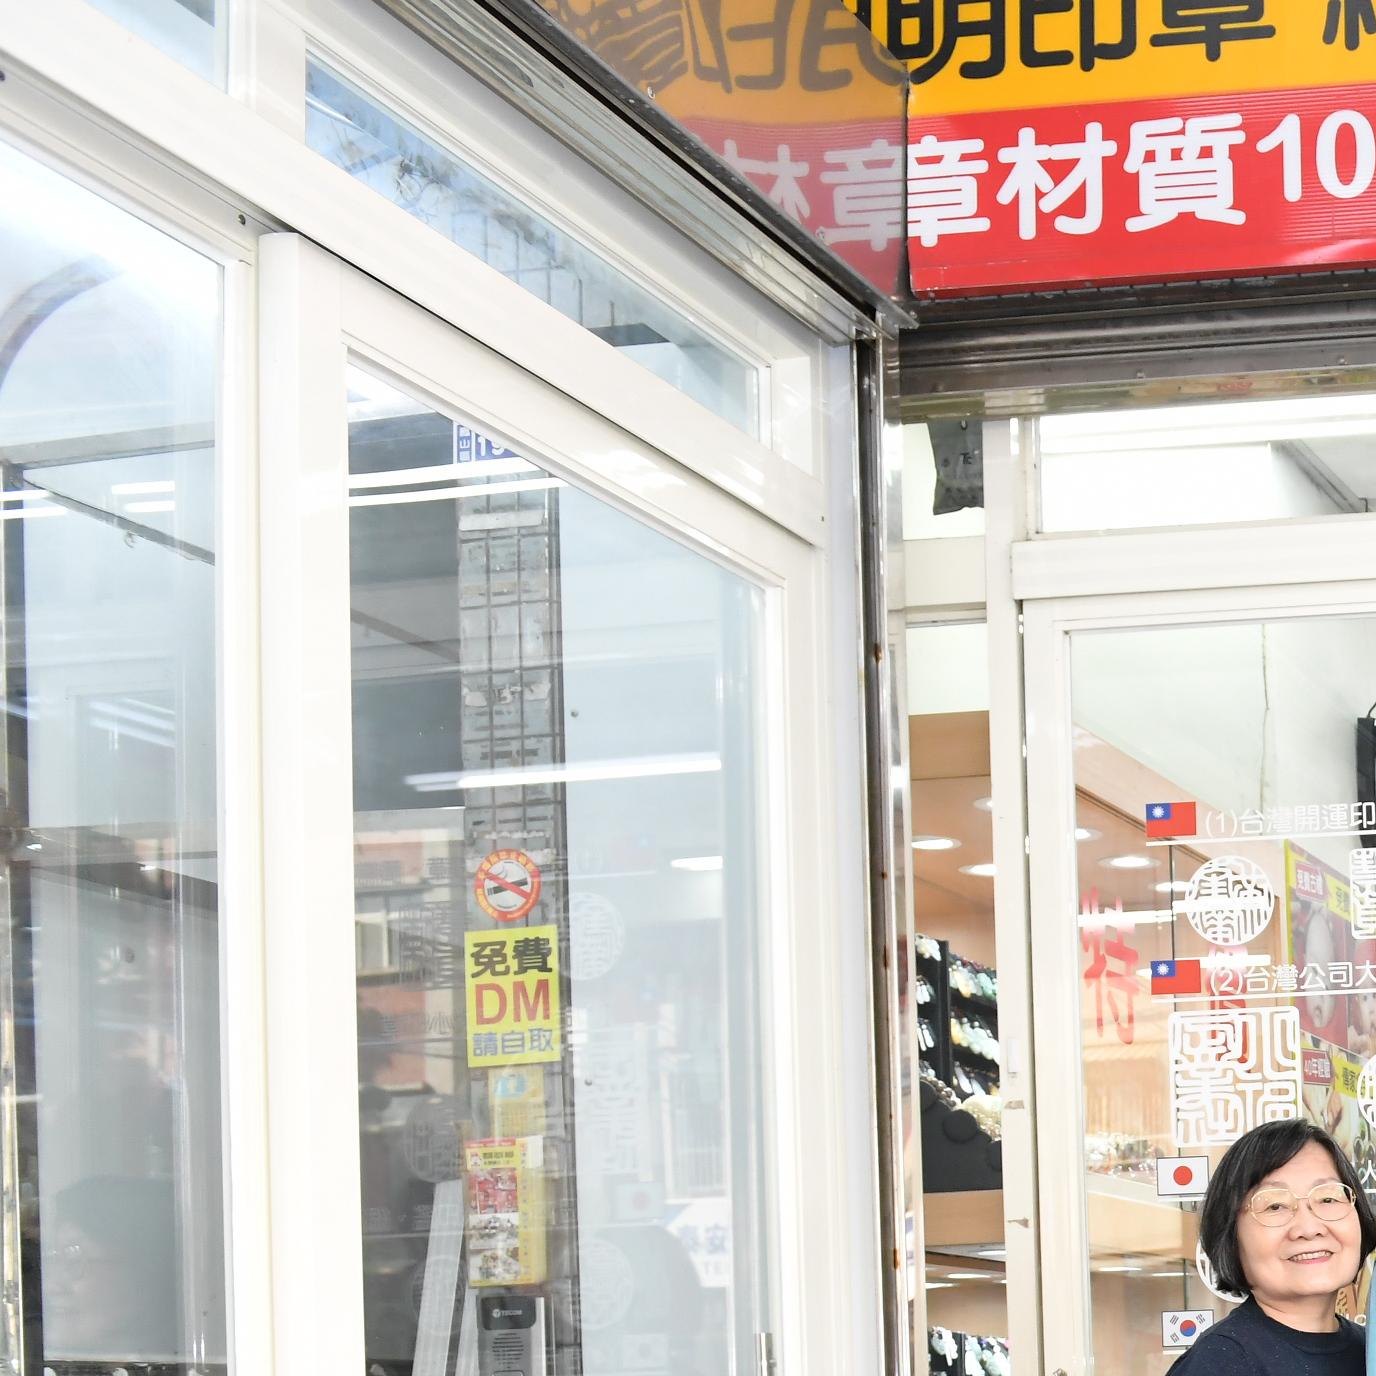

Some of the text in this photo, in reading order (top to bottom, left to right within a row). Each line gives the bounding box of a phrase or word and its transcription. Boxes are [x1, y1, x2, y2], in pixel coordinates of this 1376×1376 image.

[471, 936, 553, 978] 免費
[475, 979, 551, 1026] DM
[472, 1028, 554, 1058] 請自取
